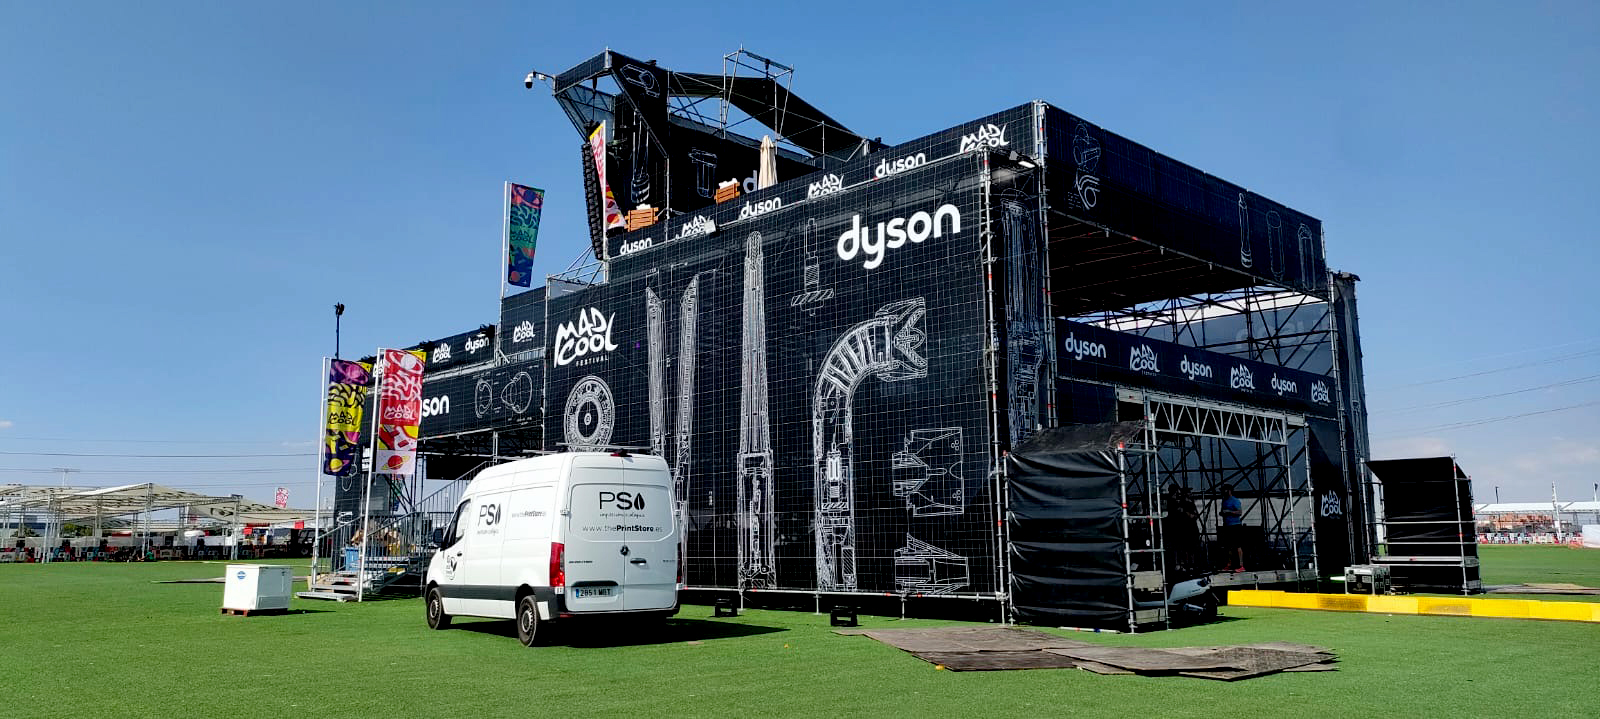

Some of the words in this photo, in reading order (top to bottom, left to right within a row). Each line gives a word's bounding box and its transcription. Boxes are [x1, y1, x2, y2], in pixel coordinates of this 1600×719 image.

[836, 203, 961, 270] dyson
[513, 320, 532, 343] MAD
[515, 322, 536, 343] COOL
[554, 307, 607, 368] MAD
[557, 312, 618, 366] COOL
[432, 342, 450, 363] MAD
[434, 345, 452, 363] COOL
[464, 336, 490, 354] dyson
[1065, 331, 1107, 361] dyson
[575, 354, 609, 367] FESTIVAL
[1129, 344, 1155, 370] MAD
[1131, 352, 1161, 373] COOL
[1180, 354, 1213, 380] dyson
[1230, 363, 1250, 389] MAD
[1231, 371, 1256, 390] COOL
[1271, 372, 1298, 396] dyson
[1310, 379, 1327, 402] MAD
[1312, 386, 1331, 403] COOL
[384, 405, 411, 419] MAD
[384, 407, 416, 420] COOL
[421, 395, 450, 417] son
[329, 410, 353, 424] MAD
[330, 413, 357, 426] COOL
[1320, 489, 1339, 517] MAD
[1322, 498, 1343, 517] COOL
